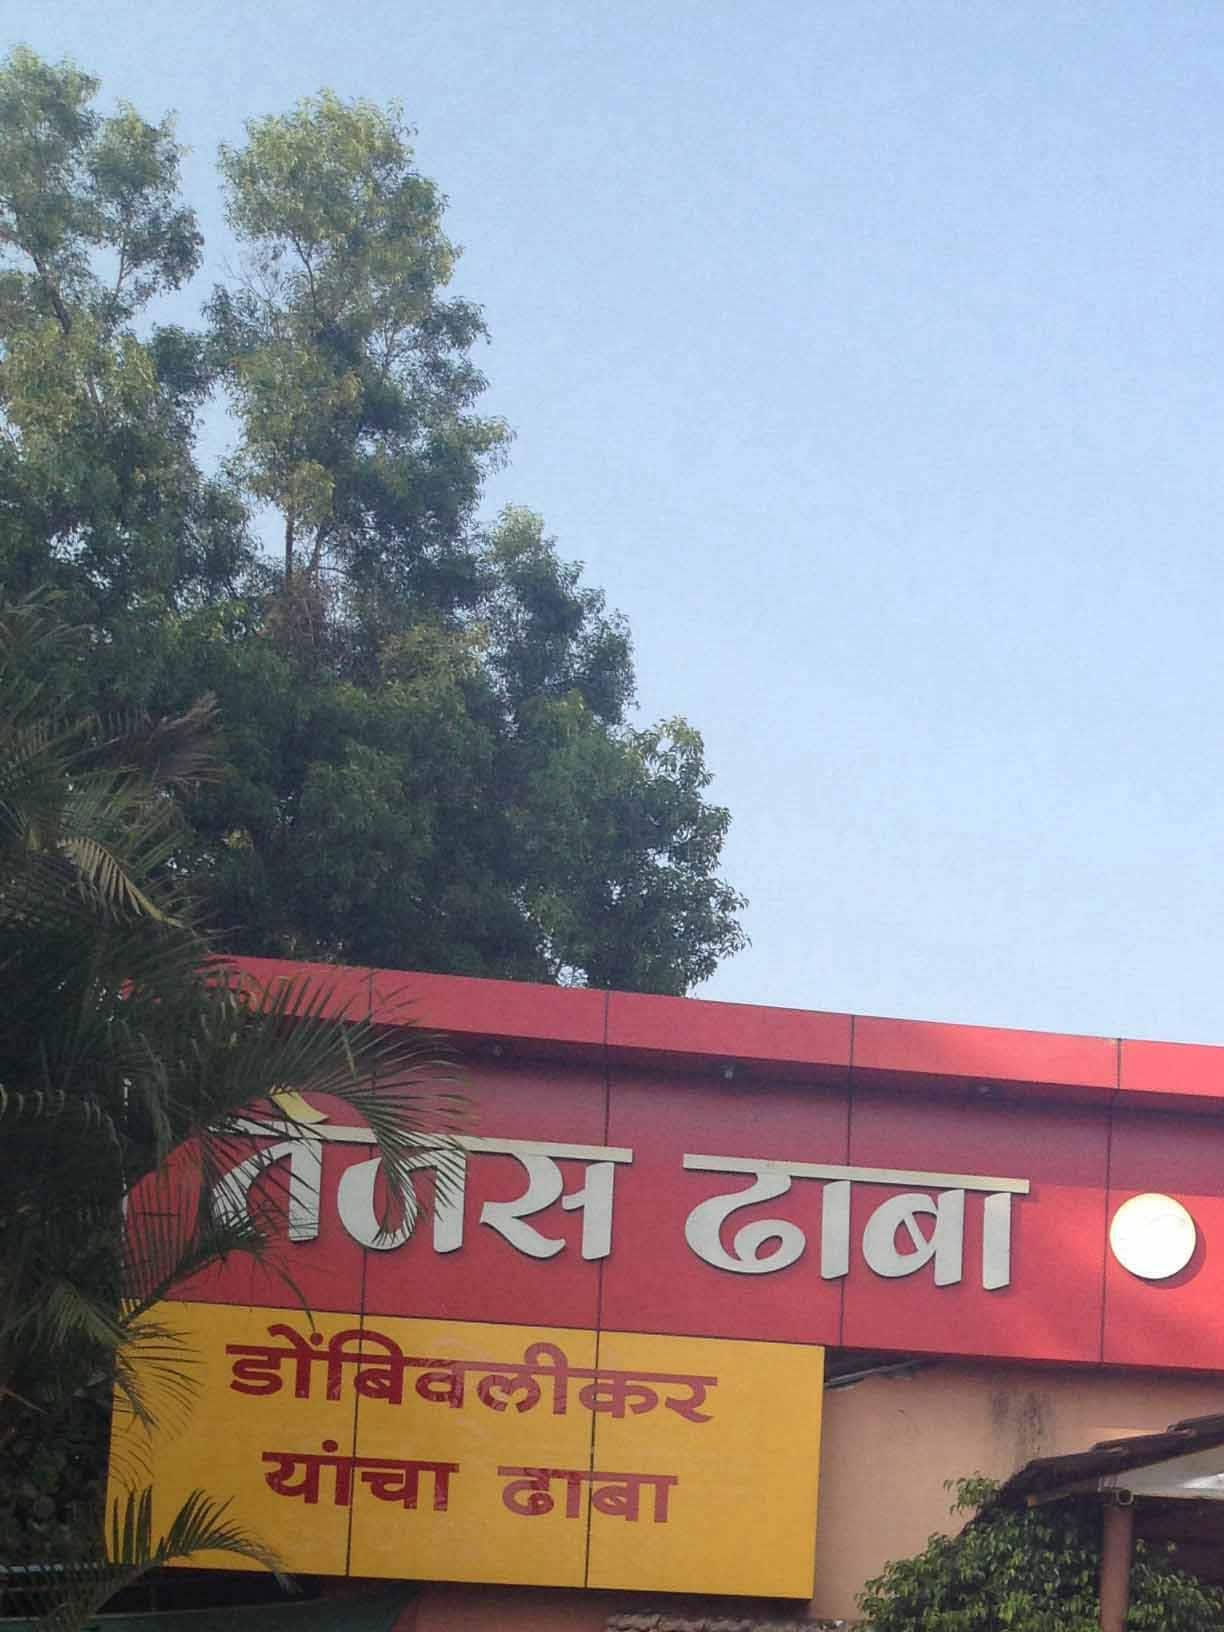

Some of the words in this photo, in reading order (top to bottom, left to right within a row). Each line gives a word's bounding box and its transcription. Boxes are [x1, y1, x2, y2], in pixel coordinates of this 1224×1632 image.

[682, 1153, 1030, 1291] ढाबा
[225, 1323, 718, 1424] डोंबिवलीकर
[262, 1440, 460, 1512] यांचा
[497, 1465, 679, 1523] ढाबा
